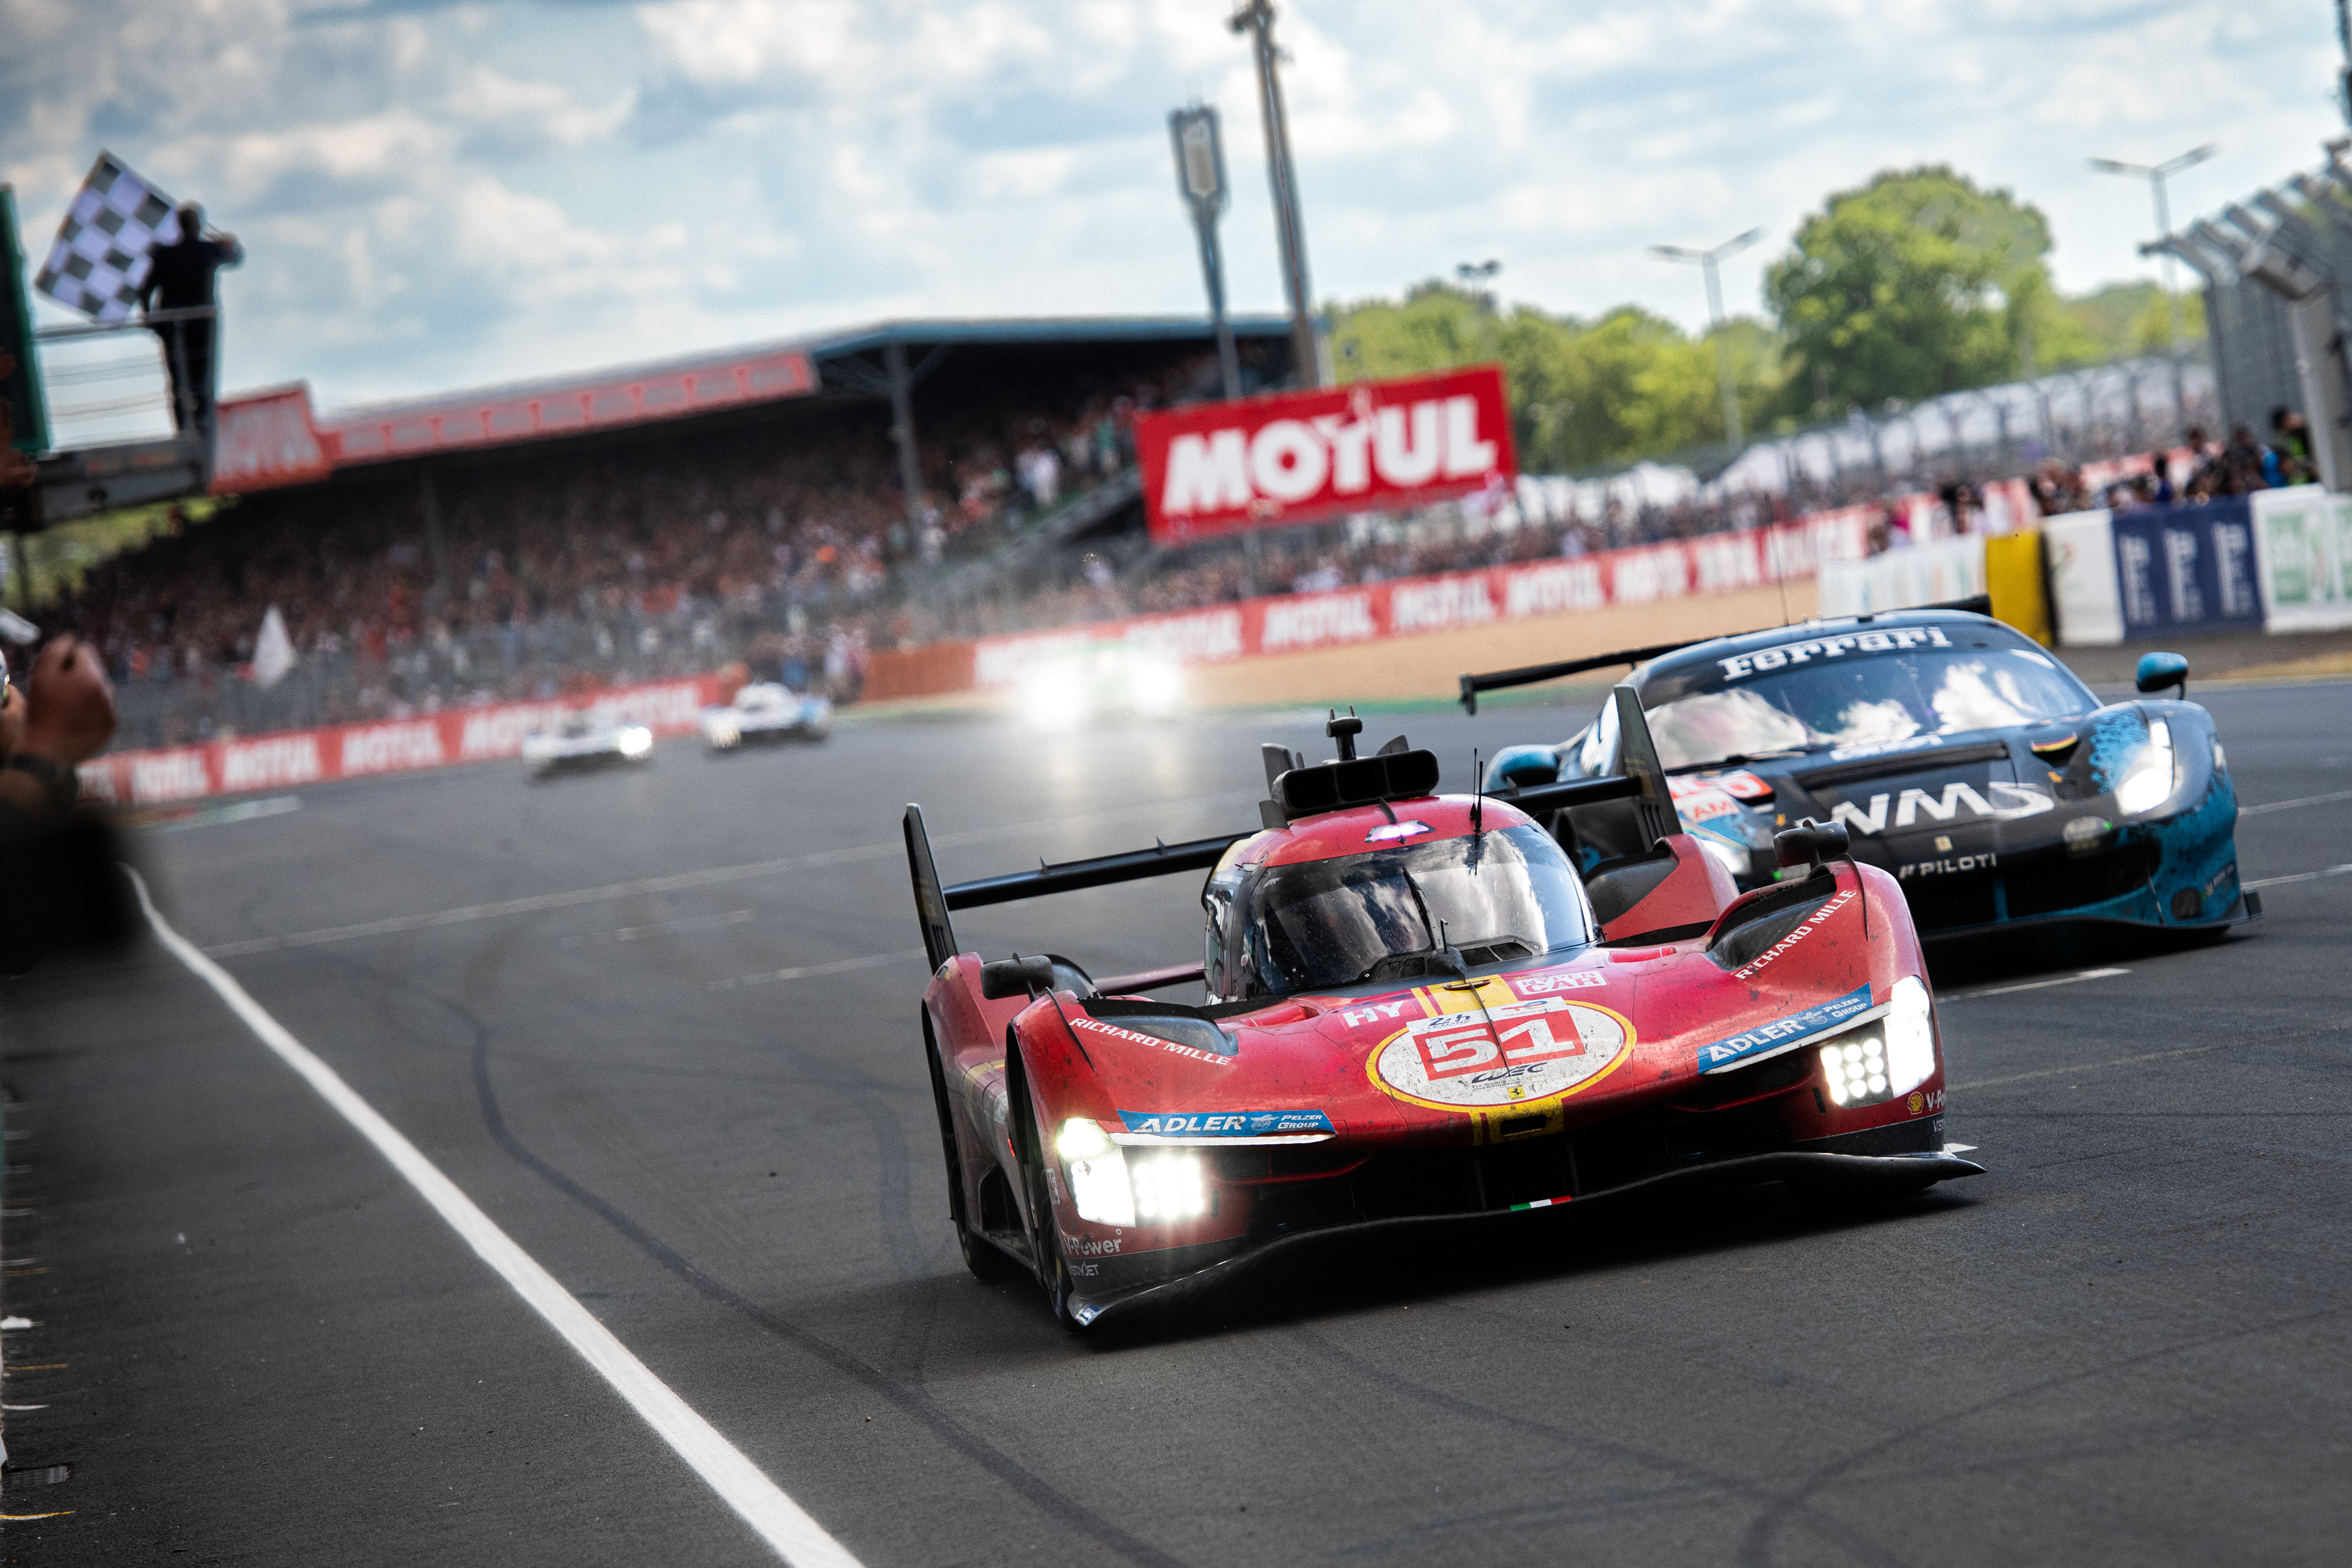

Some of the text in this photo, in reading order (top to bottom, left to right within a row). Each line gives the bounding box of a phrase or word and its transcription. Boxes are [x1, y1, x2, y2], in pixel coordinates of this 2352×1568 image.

[1161, 393, 1498, 518] MOTUL
[1716, 626, 1953, 682] Ferrari
[1918, 853, 1997, 877] PILOTI
[1809, 890, 1857, 924] MILLE
[1521, 973, 1595, 986] HYPER
[1525, 978, 1600, 992] CAR
[1343, 1001, 1404, 1027] HY
[1823, 998, 1861, 1012] PELZER
[1831, 1003, 1868, 1018] GROUP
[1069, 1018, 1232, 1065] RICHARD MILLE
[1425, 1019, 1575, 1072] 51
[1707, 1019, 1806, 1062] ADLER
[1471, 1061, 1548, 1084] WEC
[1133, 1116, 1246, 1133] ADLER
[1063, 1237, 1122, 1256] V-Power
